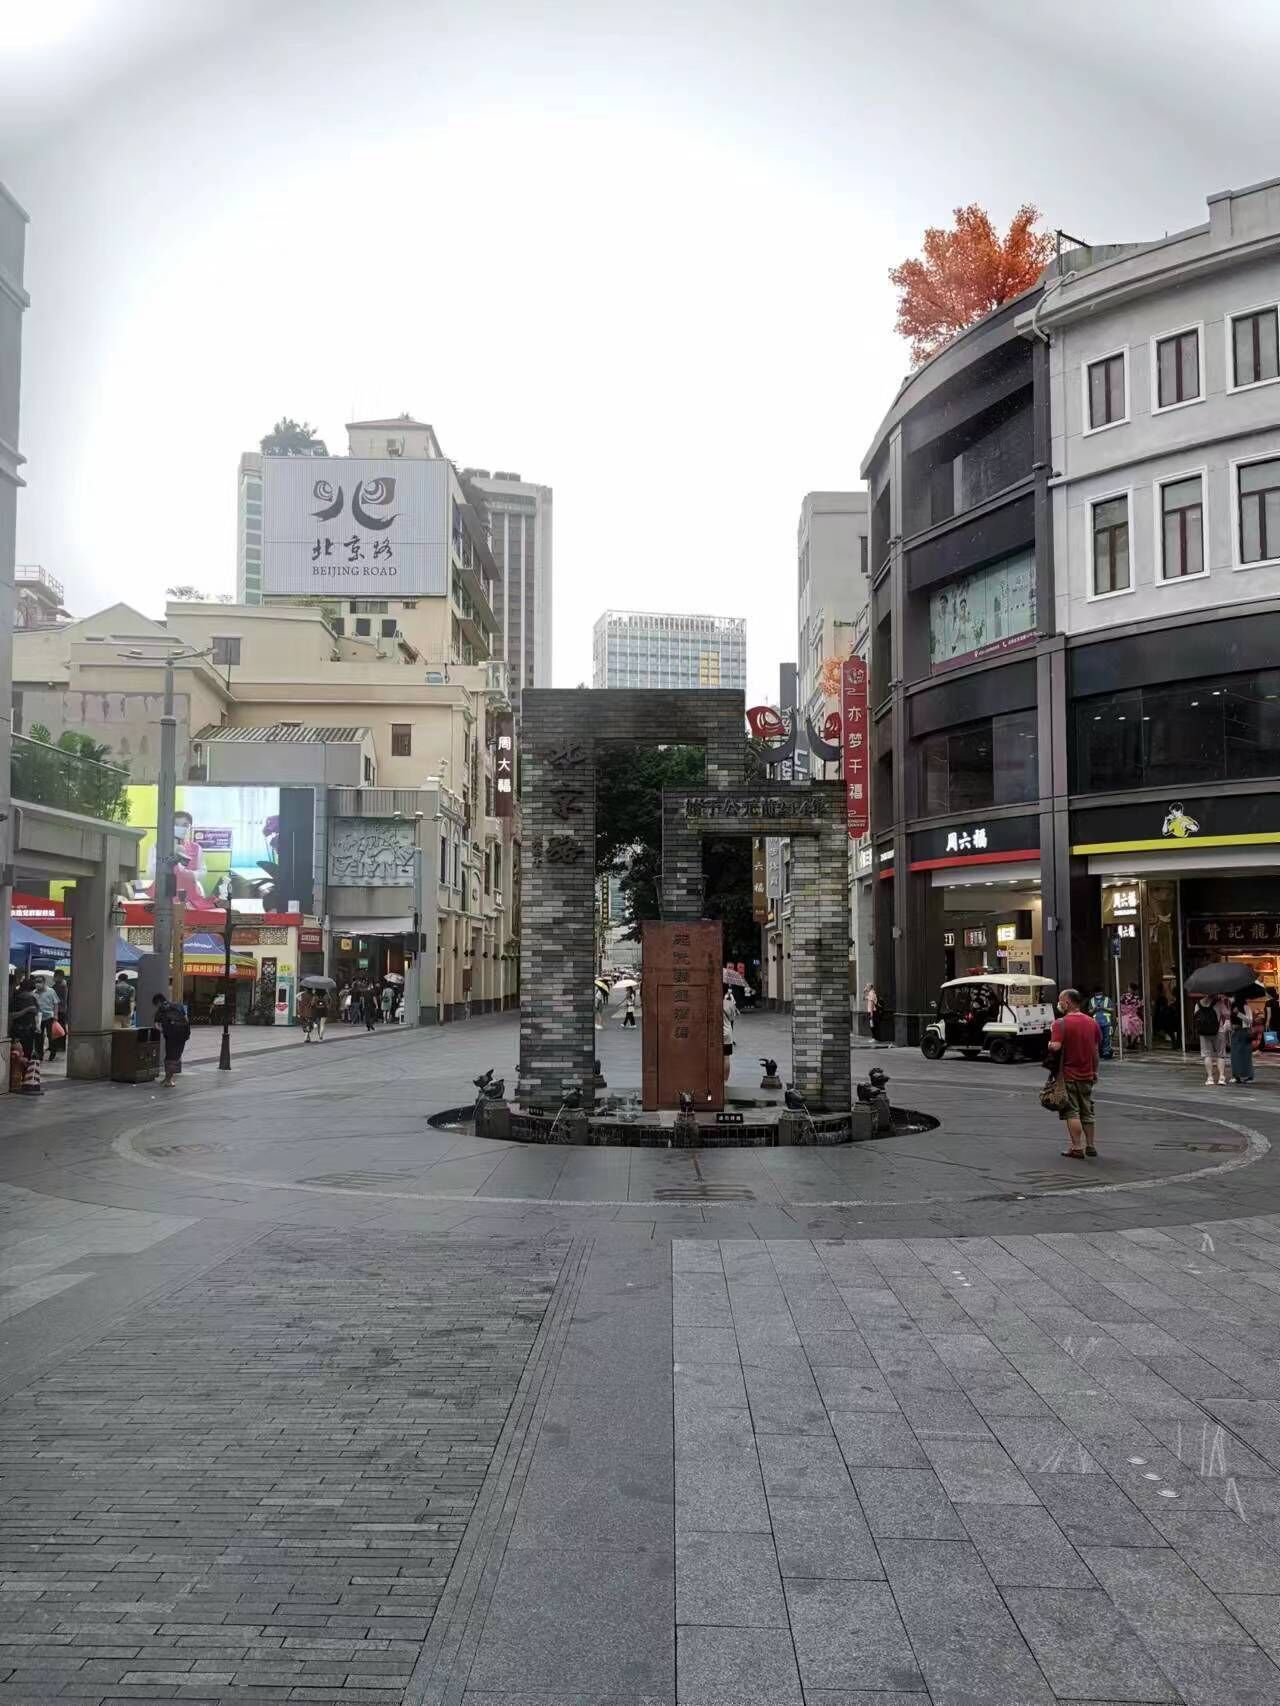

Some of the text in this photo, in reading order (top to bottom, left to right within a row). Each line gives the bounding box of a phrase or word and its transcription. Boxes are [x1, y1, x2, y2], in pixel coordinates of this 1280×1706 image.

[312, 534, 393, 562] 北京路
[312, 566, 397, 577] BEIJING ROAD
[497, 735, 512, 793] 周大福
[847, 706, 863, 799] 亦梦千福
[945, 828, 988, 852] 周六福
